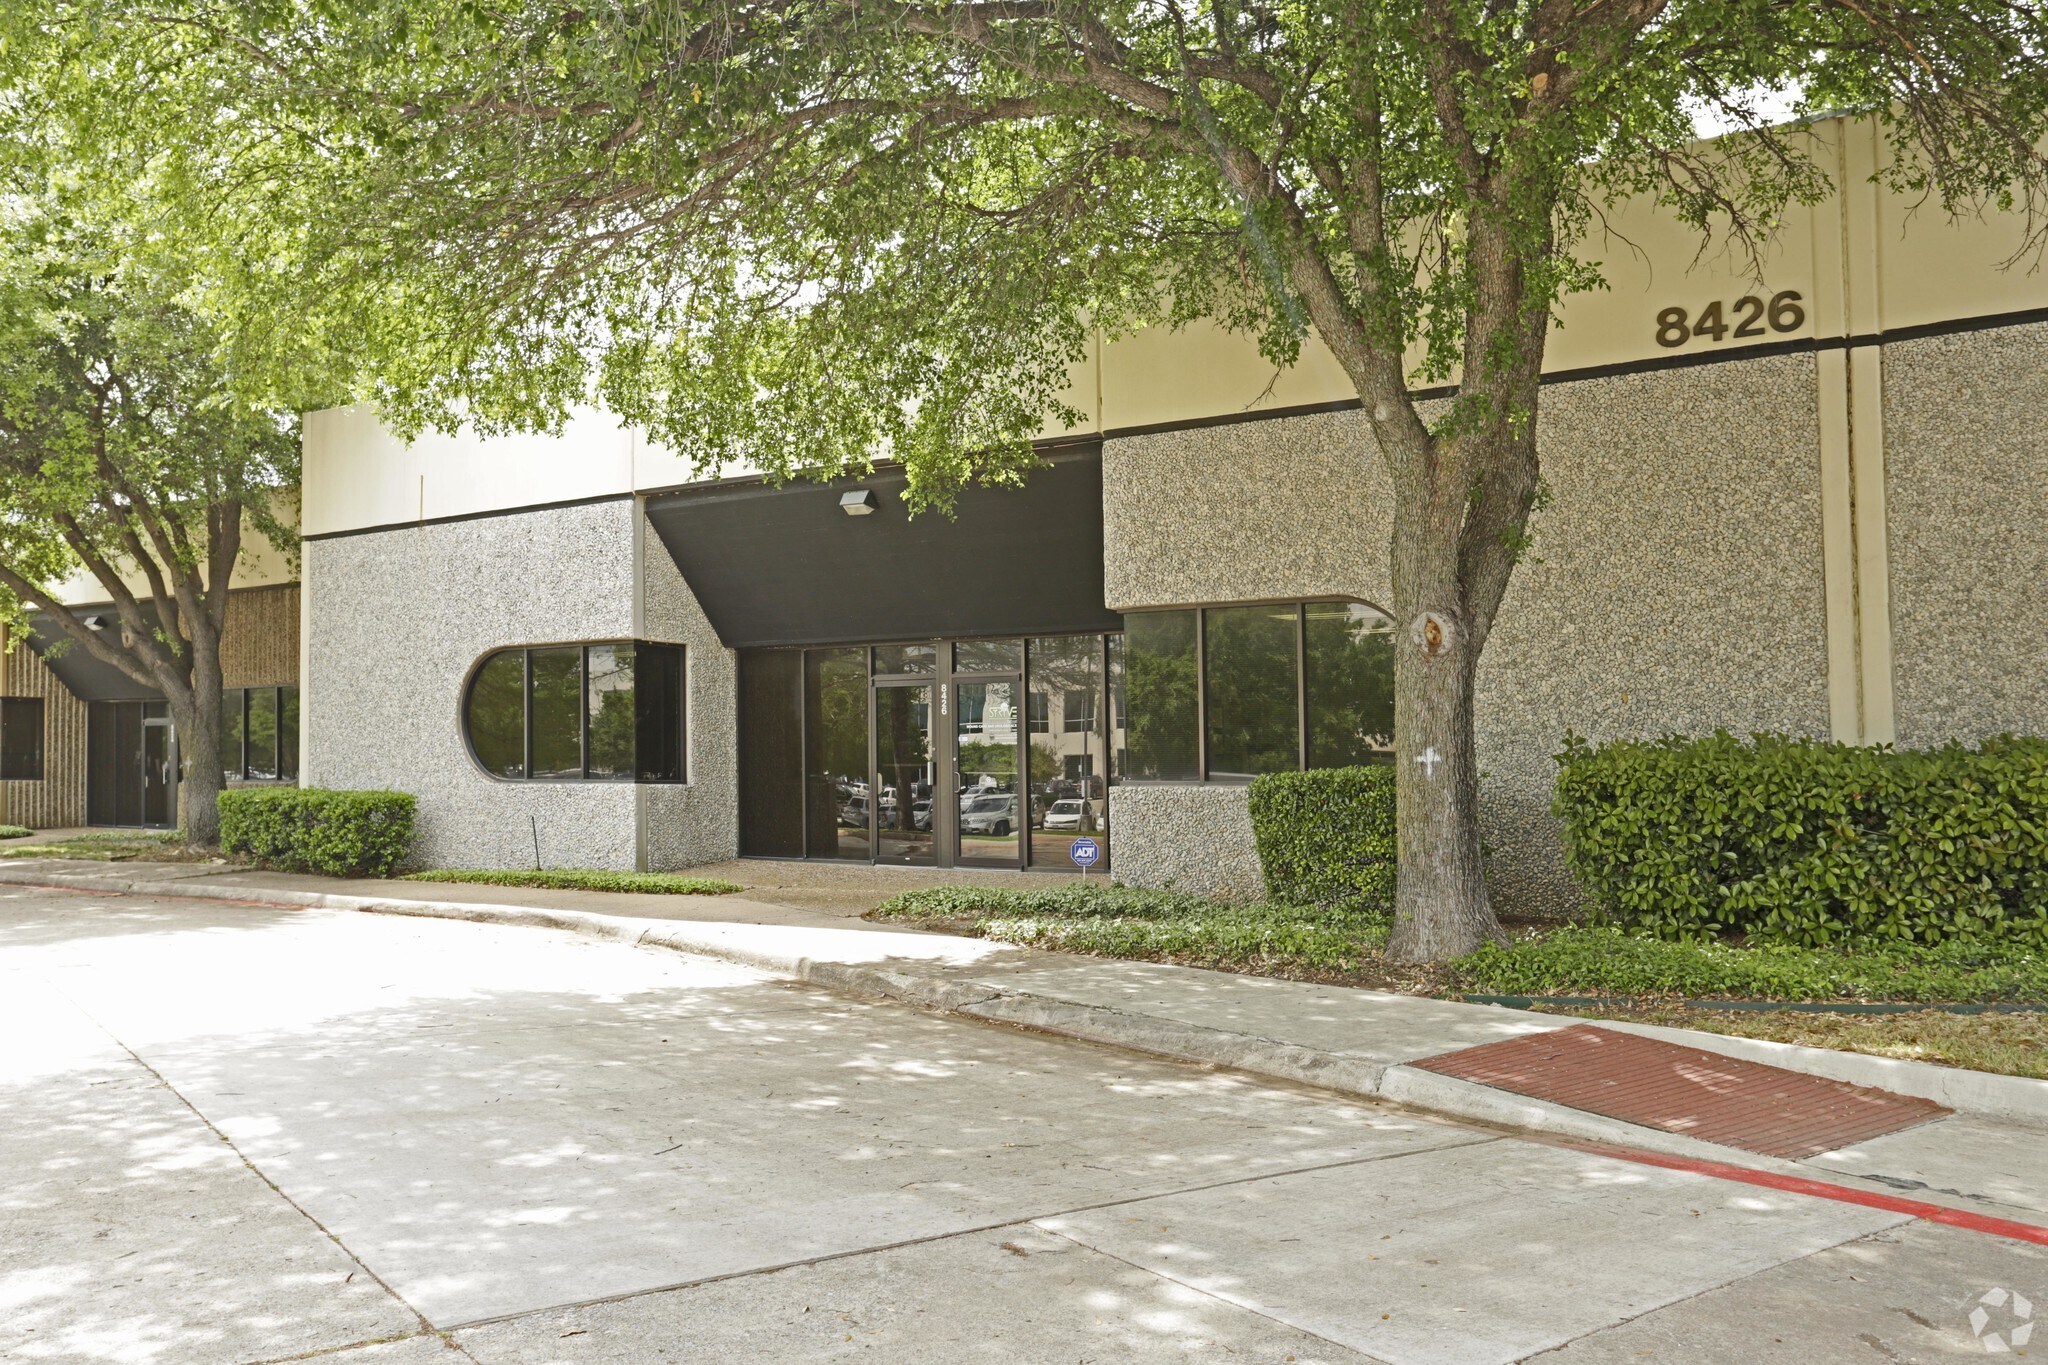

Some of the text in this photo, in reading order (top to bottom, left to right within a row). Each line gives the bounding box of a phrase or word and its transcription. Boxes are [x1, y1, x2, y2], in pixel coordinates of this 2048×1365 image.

[1656, 290, 1805, 347] 8426
[989, 704, 1017, 718] STRIVE
[1075, 847, 1094, 858] ADT
